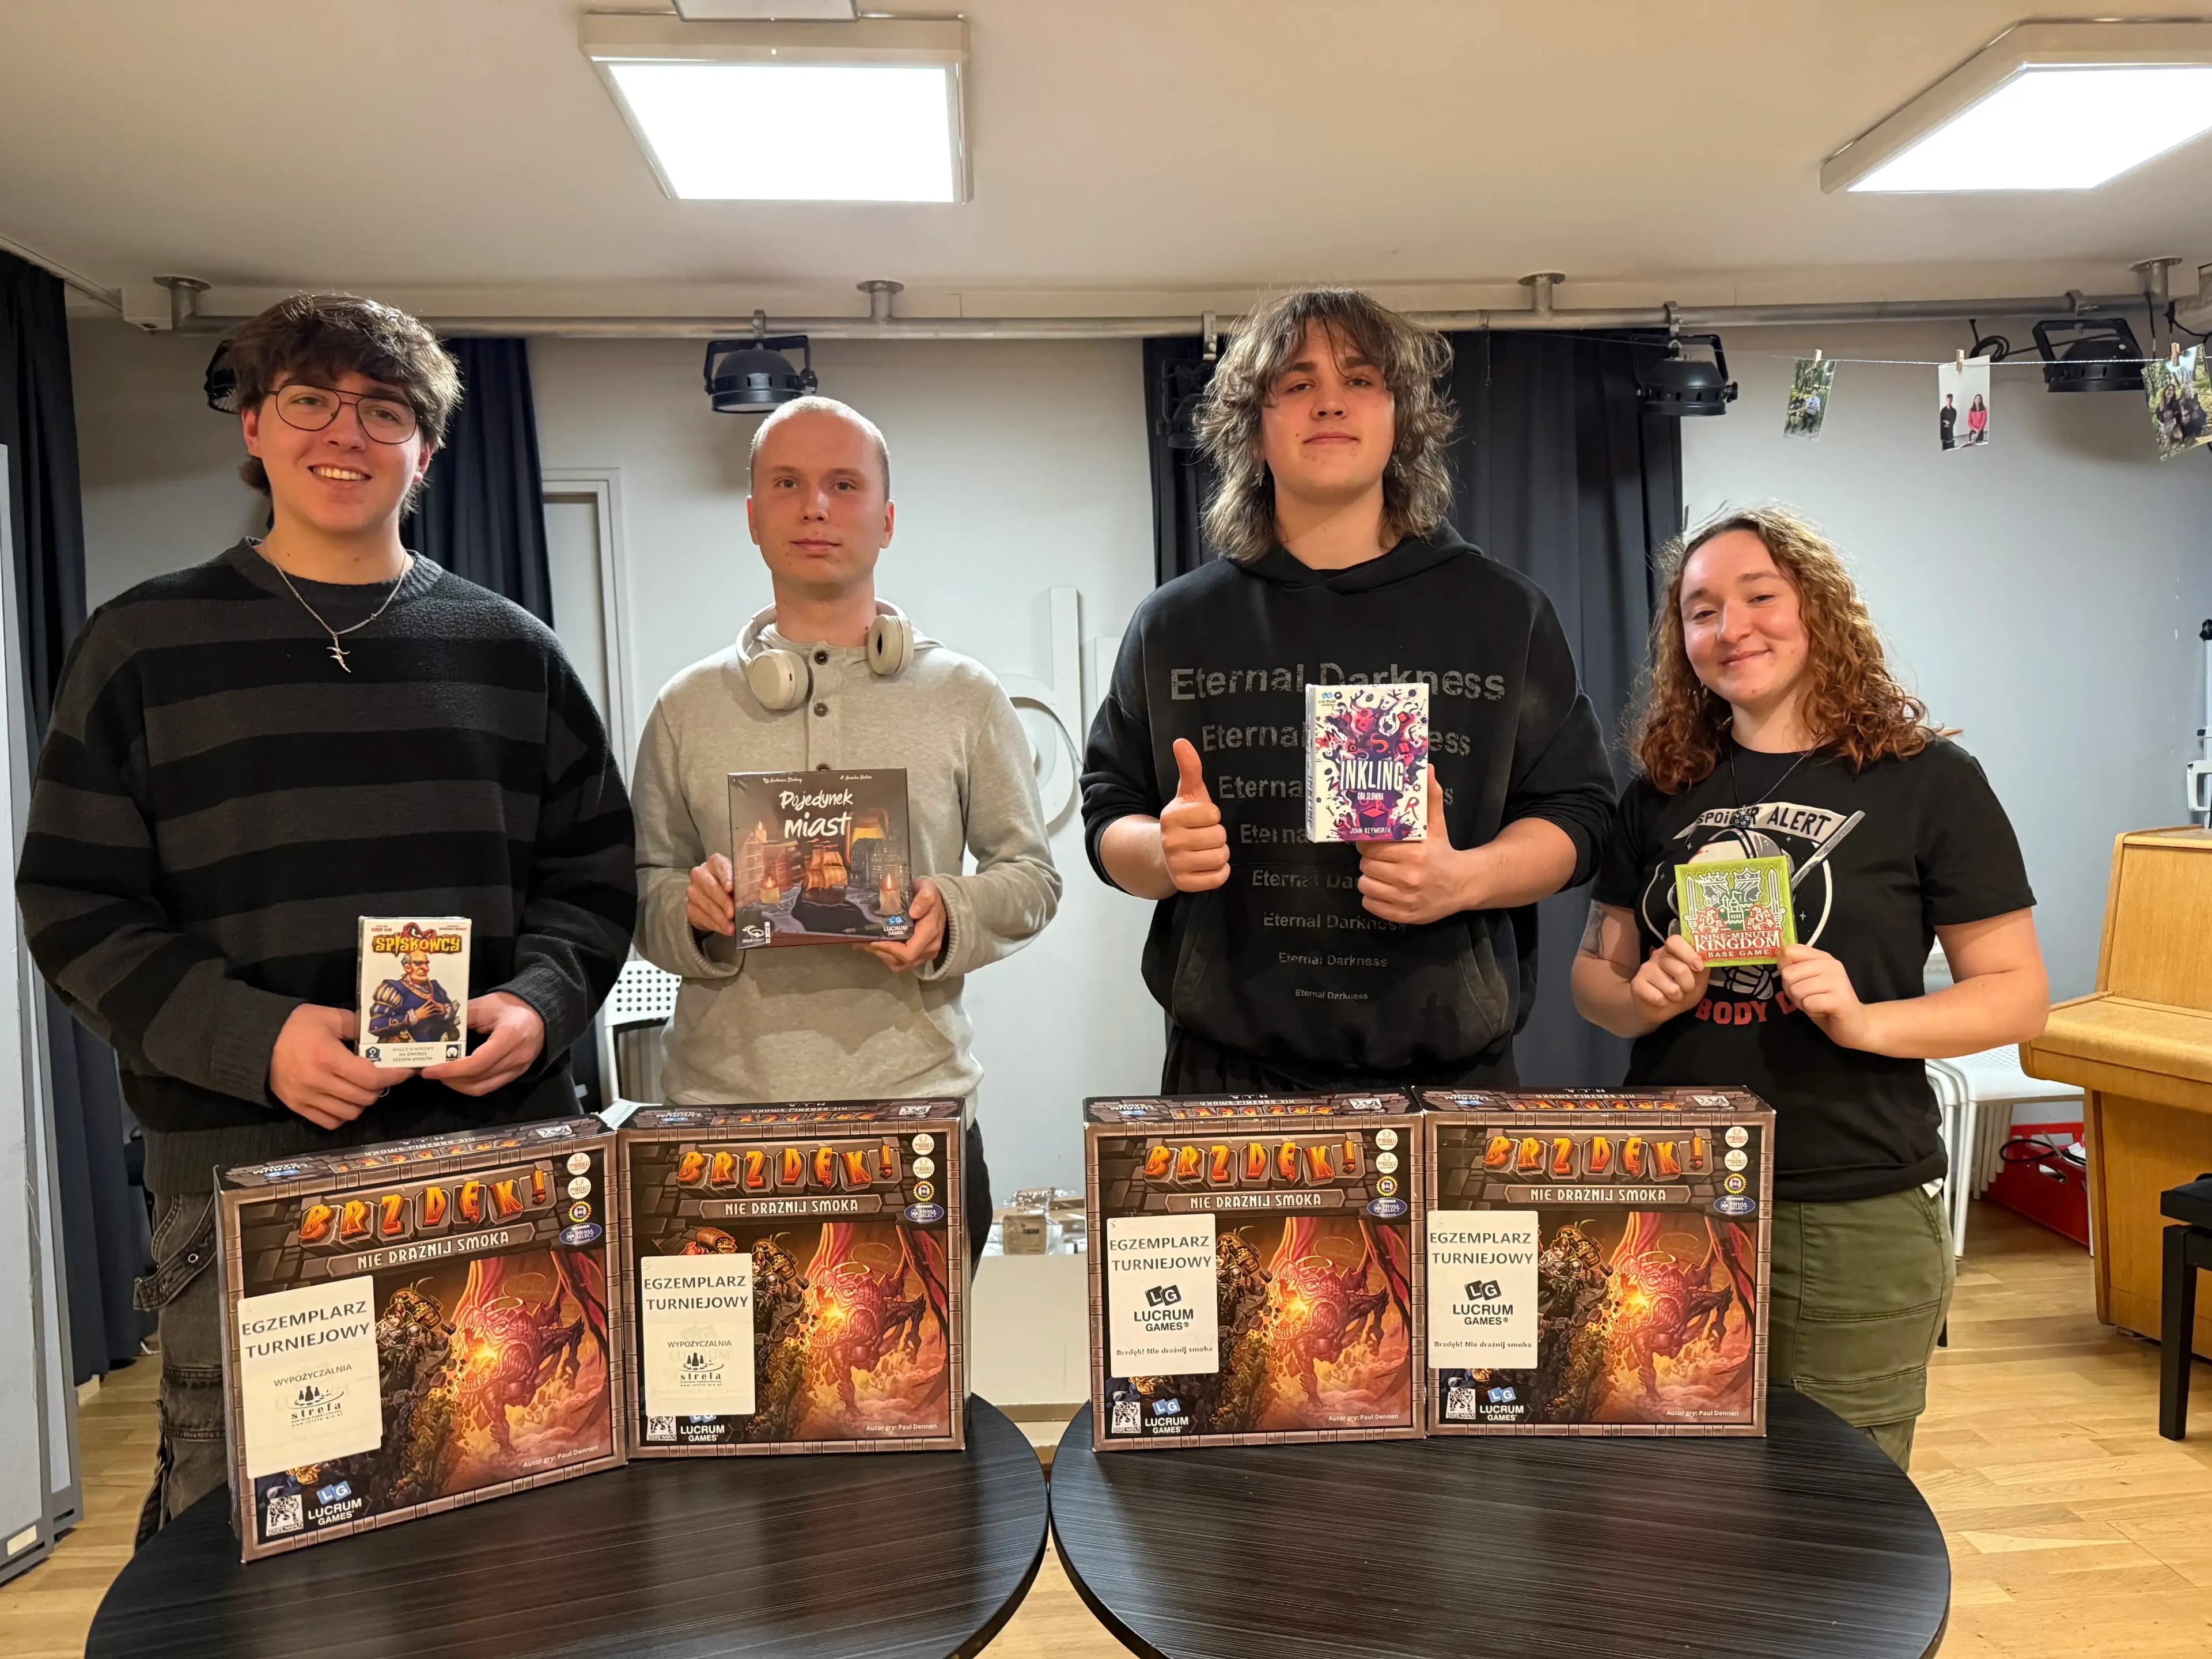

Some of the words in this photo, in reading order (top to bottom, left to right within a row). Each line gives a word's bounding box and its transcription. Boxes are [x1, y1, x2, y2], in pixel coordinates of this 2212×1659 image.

[1171, 664, 1304, 700] Eternal
[1340, 760, 1404, 791] INKLING
[1218, 775, 1305, 799] Eterna
[779, 788, 854, 811] Pojedynek
[784, 810, 853, 838] miast
[1767, 806, 1832, 836] ALERT
[1240, 823, 1308, 844] Eterna
[1263, 912, 1321, 929] Eternal
[375, 935, 460, 954] SPISKOWCY
[1695, 930, 1780, 953] KINGDOM
[1700, 931, 1774, 941] NINE-MINUTE
[1278, 952, 1323, 965] Eternal
[1327, 955, 1387, 967] Darkness
[1295, 988, 1325, 999] Eternal
[1327, 991, 1368, 1000] Darkness
[369, 1048, 376, 1058] 2
[575, 1160, 589, 1168] ROKU
[1143, 1139, 1356, 1183] BRZDĘK!
[1483, 1135, 1704, 1176] BRZDĘK!
[677, 1145, 893, 1188] BRZDĘK!
[575, 1184, 590, 1193] ROKU
[1530, 1188, 1552, 1201] NIE
[1557, 1186, 1613, 1201] DRAŻNIJ
[1618, 1188, 1666, 1201] SMOKA
[299, 1169, 547, 1240] BRZDĘK!
[725, 1203, 747, 1216] NIE
[752, 1199, 806, 1215] DRAŻNIJ
[812, 1199, 858, 1213] SMOKA
[1190, 1196, 1211, 1209] NIE
[1216, 1192, 1270, 1208] DRAŻNIJ
[1275, 1193, 1321, 1207] SMOKA
[1110, 1235, 1209, 1251] EGZEMPLARZ
[1430, 1232, 1531, 1245] EGZEMPLARZ
[358, 1253, 382, 1270] NIE
[389, 1241, 452, 1266] DRAŻNIJ
[458, 1232, 509, 1251] SMOKA
[1431, 1252, 1533, 1265] TURNIEJOWY
[1112, 1256, 1211, 1271] TURNIEJOWY
[643, 1275, 747, 1290] EGZEMPLARZ
[1468, 1282, 1499, 1299] LG
[646, 1296, 748, 1310] TURNIEJOWY
[1149, 1287, 1179, 1305] LG
[242, 1301, 368, 1336] EGZEMPLARZ
[1134, 1309, 1194, 1322] LUCRUM
[1453, 1304, 1513, 1316] LUCRUM
[245, 1323, 370, 1358] TURNIEJOWY
[668, 1339, 732, 1348] WYPOŻYCZALNIA
[1434, 1341, 1463, 1350] Brzdęk!
[1479, 1341, 1505, 1350] drażnij
[1147, 1347, 1160, 1355] Nie
[1161, 1346, 1187, 1355] drażnij
[274, 1363, 353, 1387] WYPOŻYCZALNIA
[680, 1372, 722, 1381] strefa
[1488, 1388, 1514, 1402] LG
[291, 1403, 342, 1420] strefa
[1154, 1399, 1179, 1414] LG
[1479, 1405, 1524, 1414] LUCRUM
[680, 1425, 725, 1434] LUCRUM
[1145, 1416, 1188, 1427] LUCRUM
[523, 1459, 543, 1468] Autor
[557, 1451, 572, 1460] Paul
[573, 1445, 599, 1456] Dennen
[320, 1484, 349, 1502] LG
[308, 1498, 362, 1520] LUCRUM
[318, 1511, 353, 1526] GAMES
